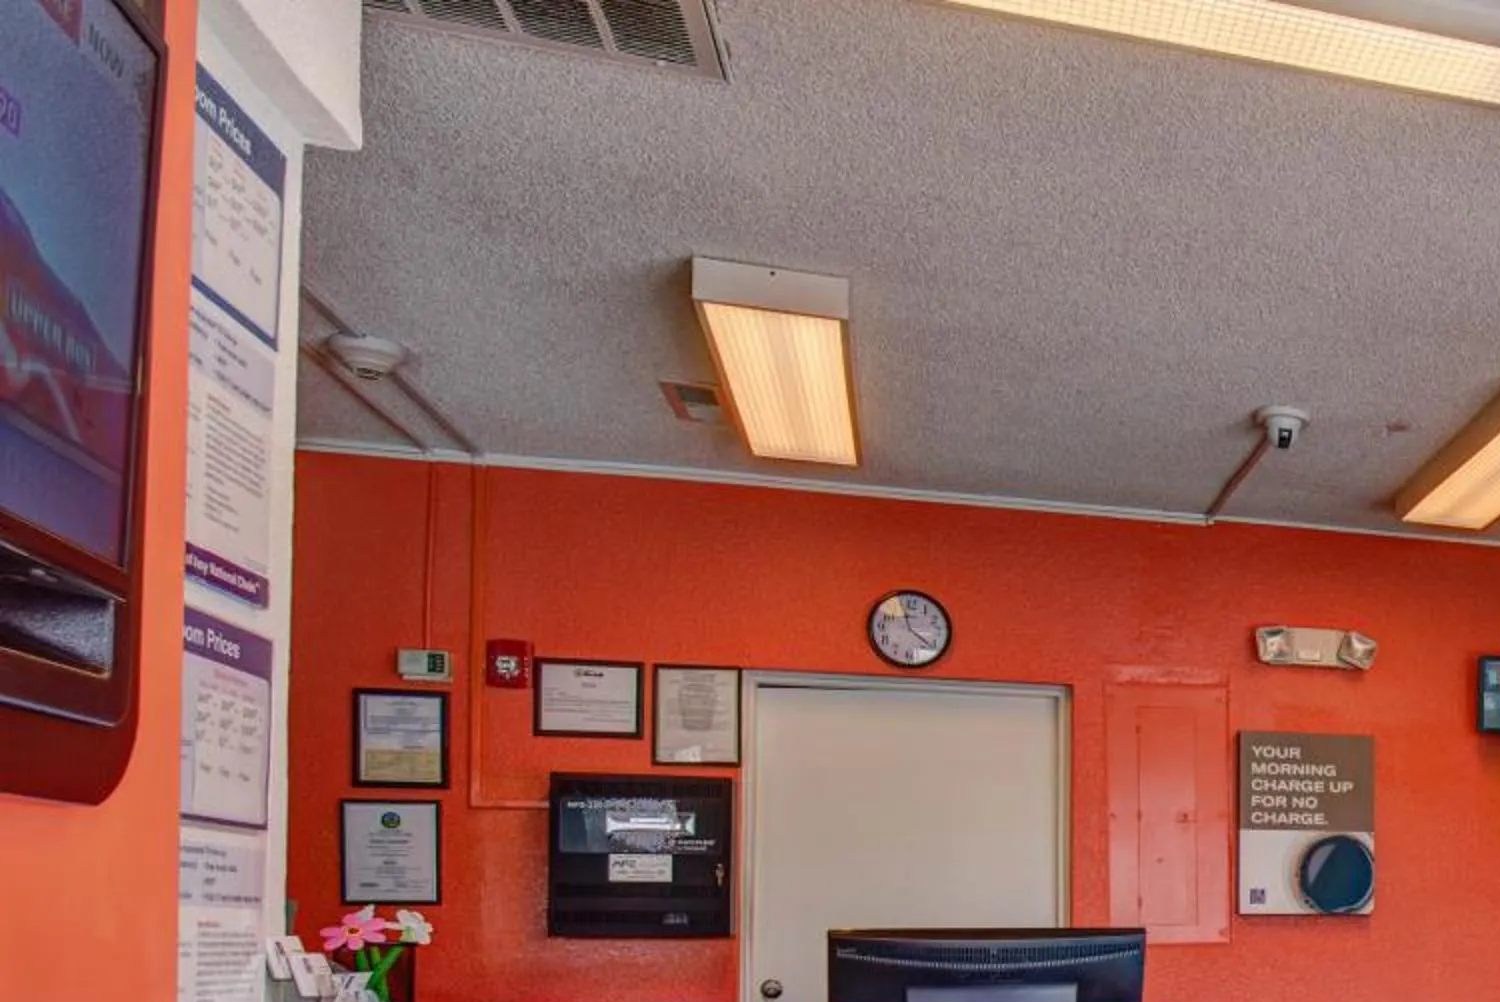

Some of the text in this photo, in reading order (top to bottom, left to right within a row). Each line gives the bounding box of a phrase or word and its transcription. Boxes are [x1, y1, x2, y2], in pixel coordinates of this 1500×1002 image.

[207, 627, 241, 660] Prices
[1251, 745, 1301, 760] YOUR
[1251, 762, 1337, 777] MORNING
[1251, 778, 1354, 793] CHARGE UP
[1251, 795, 1318, 809] FOR NO
[1251, 811, 1329, 826] CHARGE.
